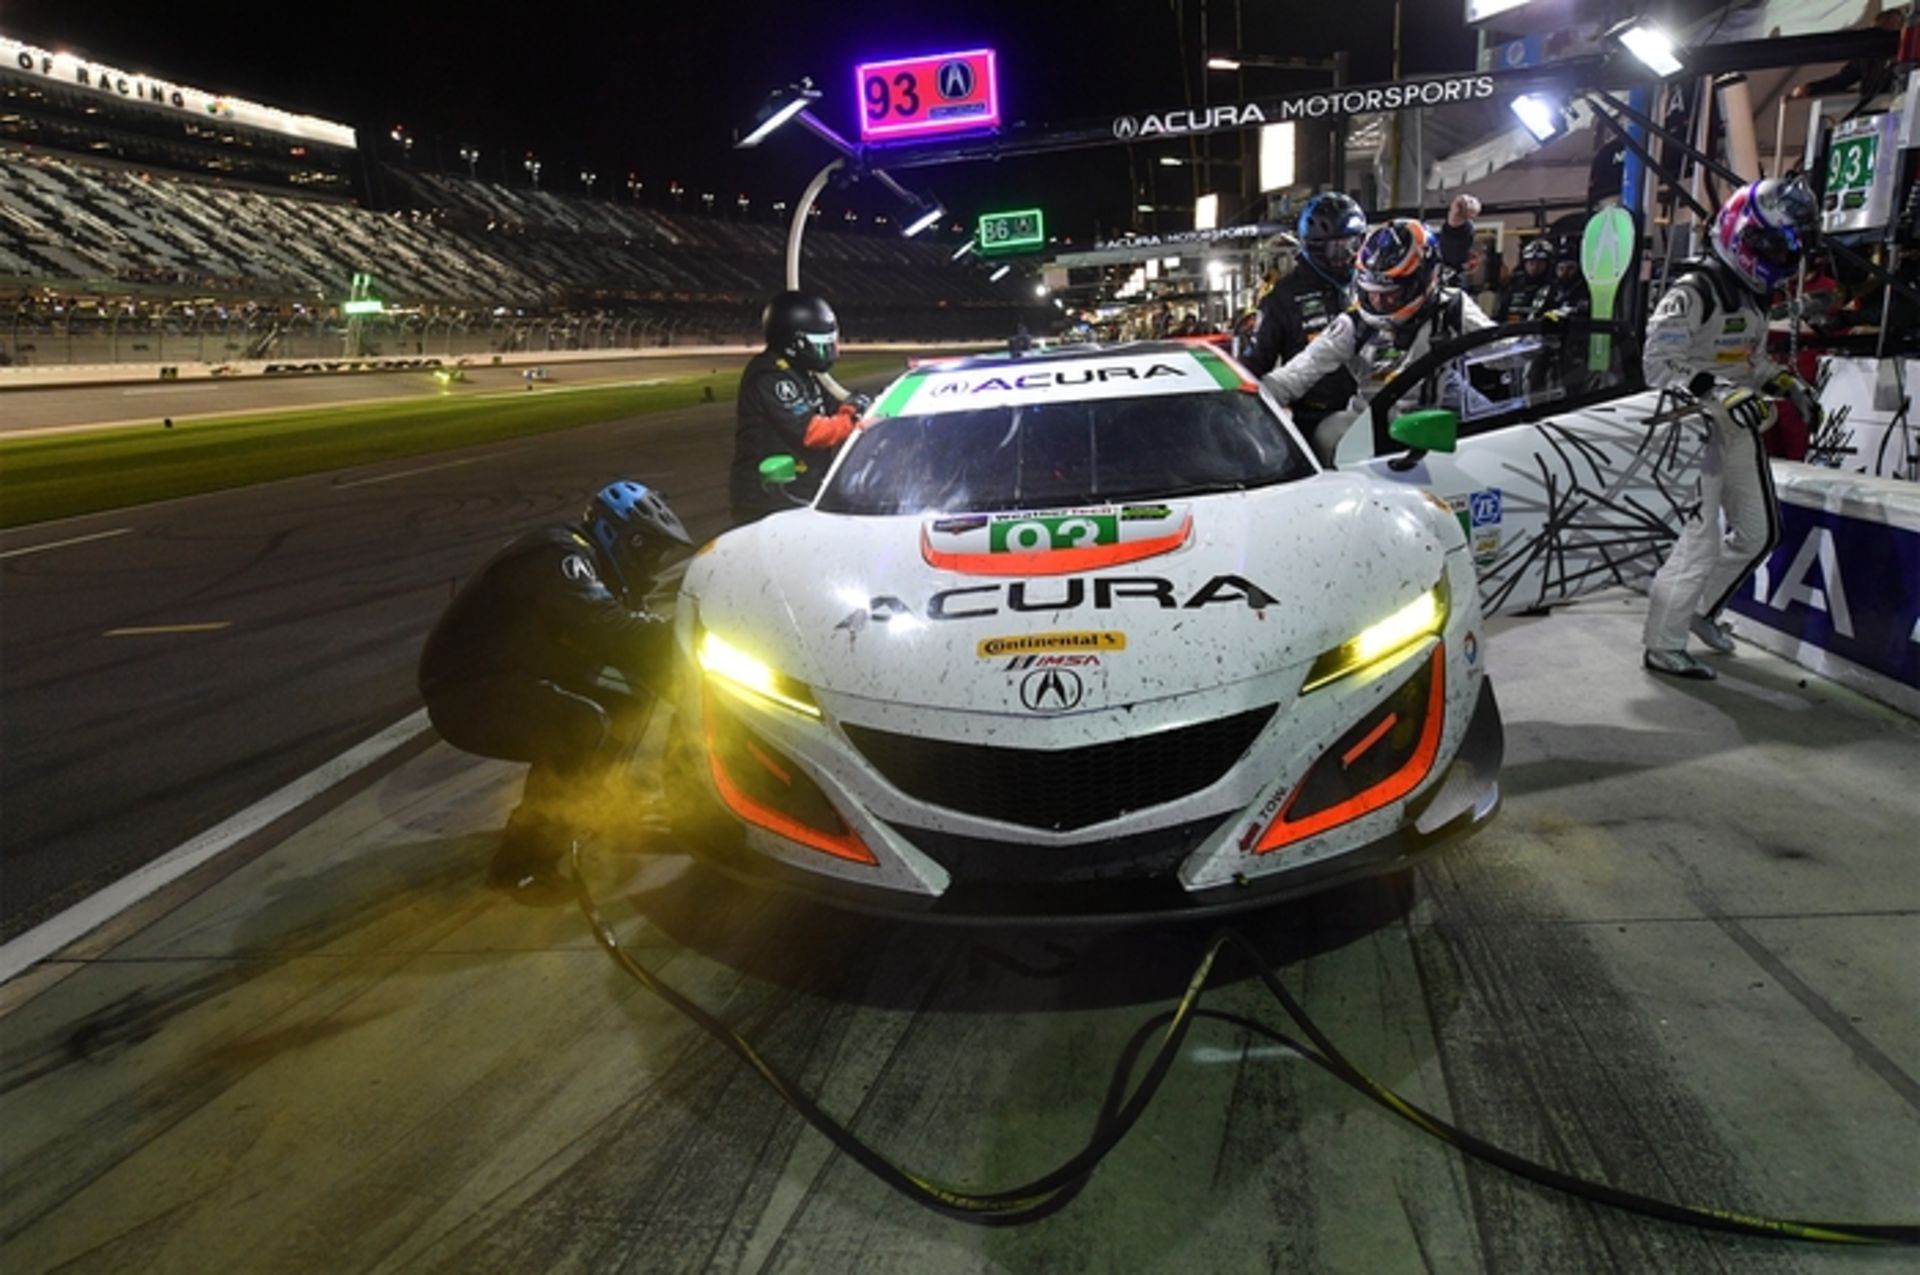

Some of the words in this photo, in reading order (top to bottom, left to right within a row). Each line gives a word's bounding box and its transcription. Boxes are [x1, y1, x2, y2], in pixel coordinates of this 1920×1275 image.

[18, 52, 52, 74] OF
[76, 67, 184, 108] RACING
[865, 73, 920, 120] 93
[1139, 103, 1266, 136] ACURA
[1281, 76, 1494, 118] MOTORSPORTS
[1827, 145, 1862, 187] 93
[1107, 235, 1161, 248] ACURA
[972, 364, 1187, 393] ACURA
[834, 575, 1281, 629] ACURA
[985, 634, 1098, 655] Continental
[1036, 655, 1100, 667] IMSA
[1259, 786, 1288, 819] TOW
